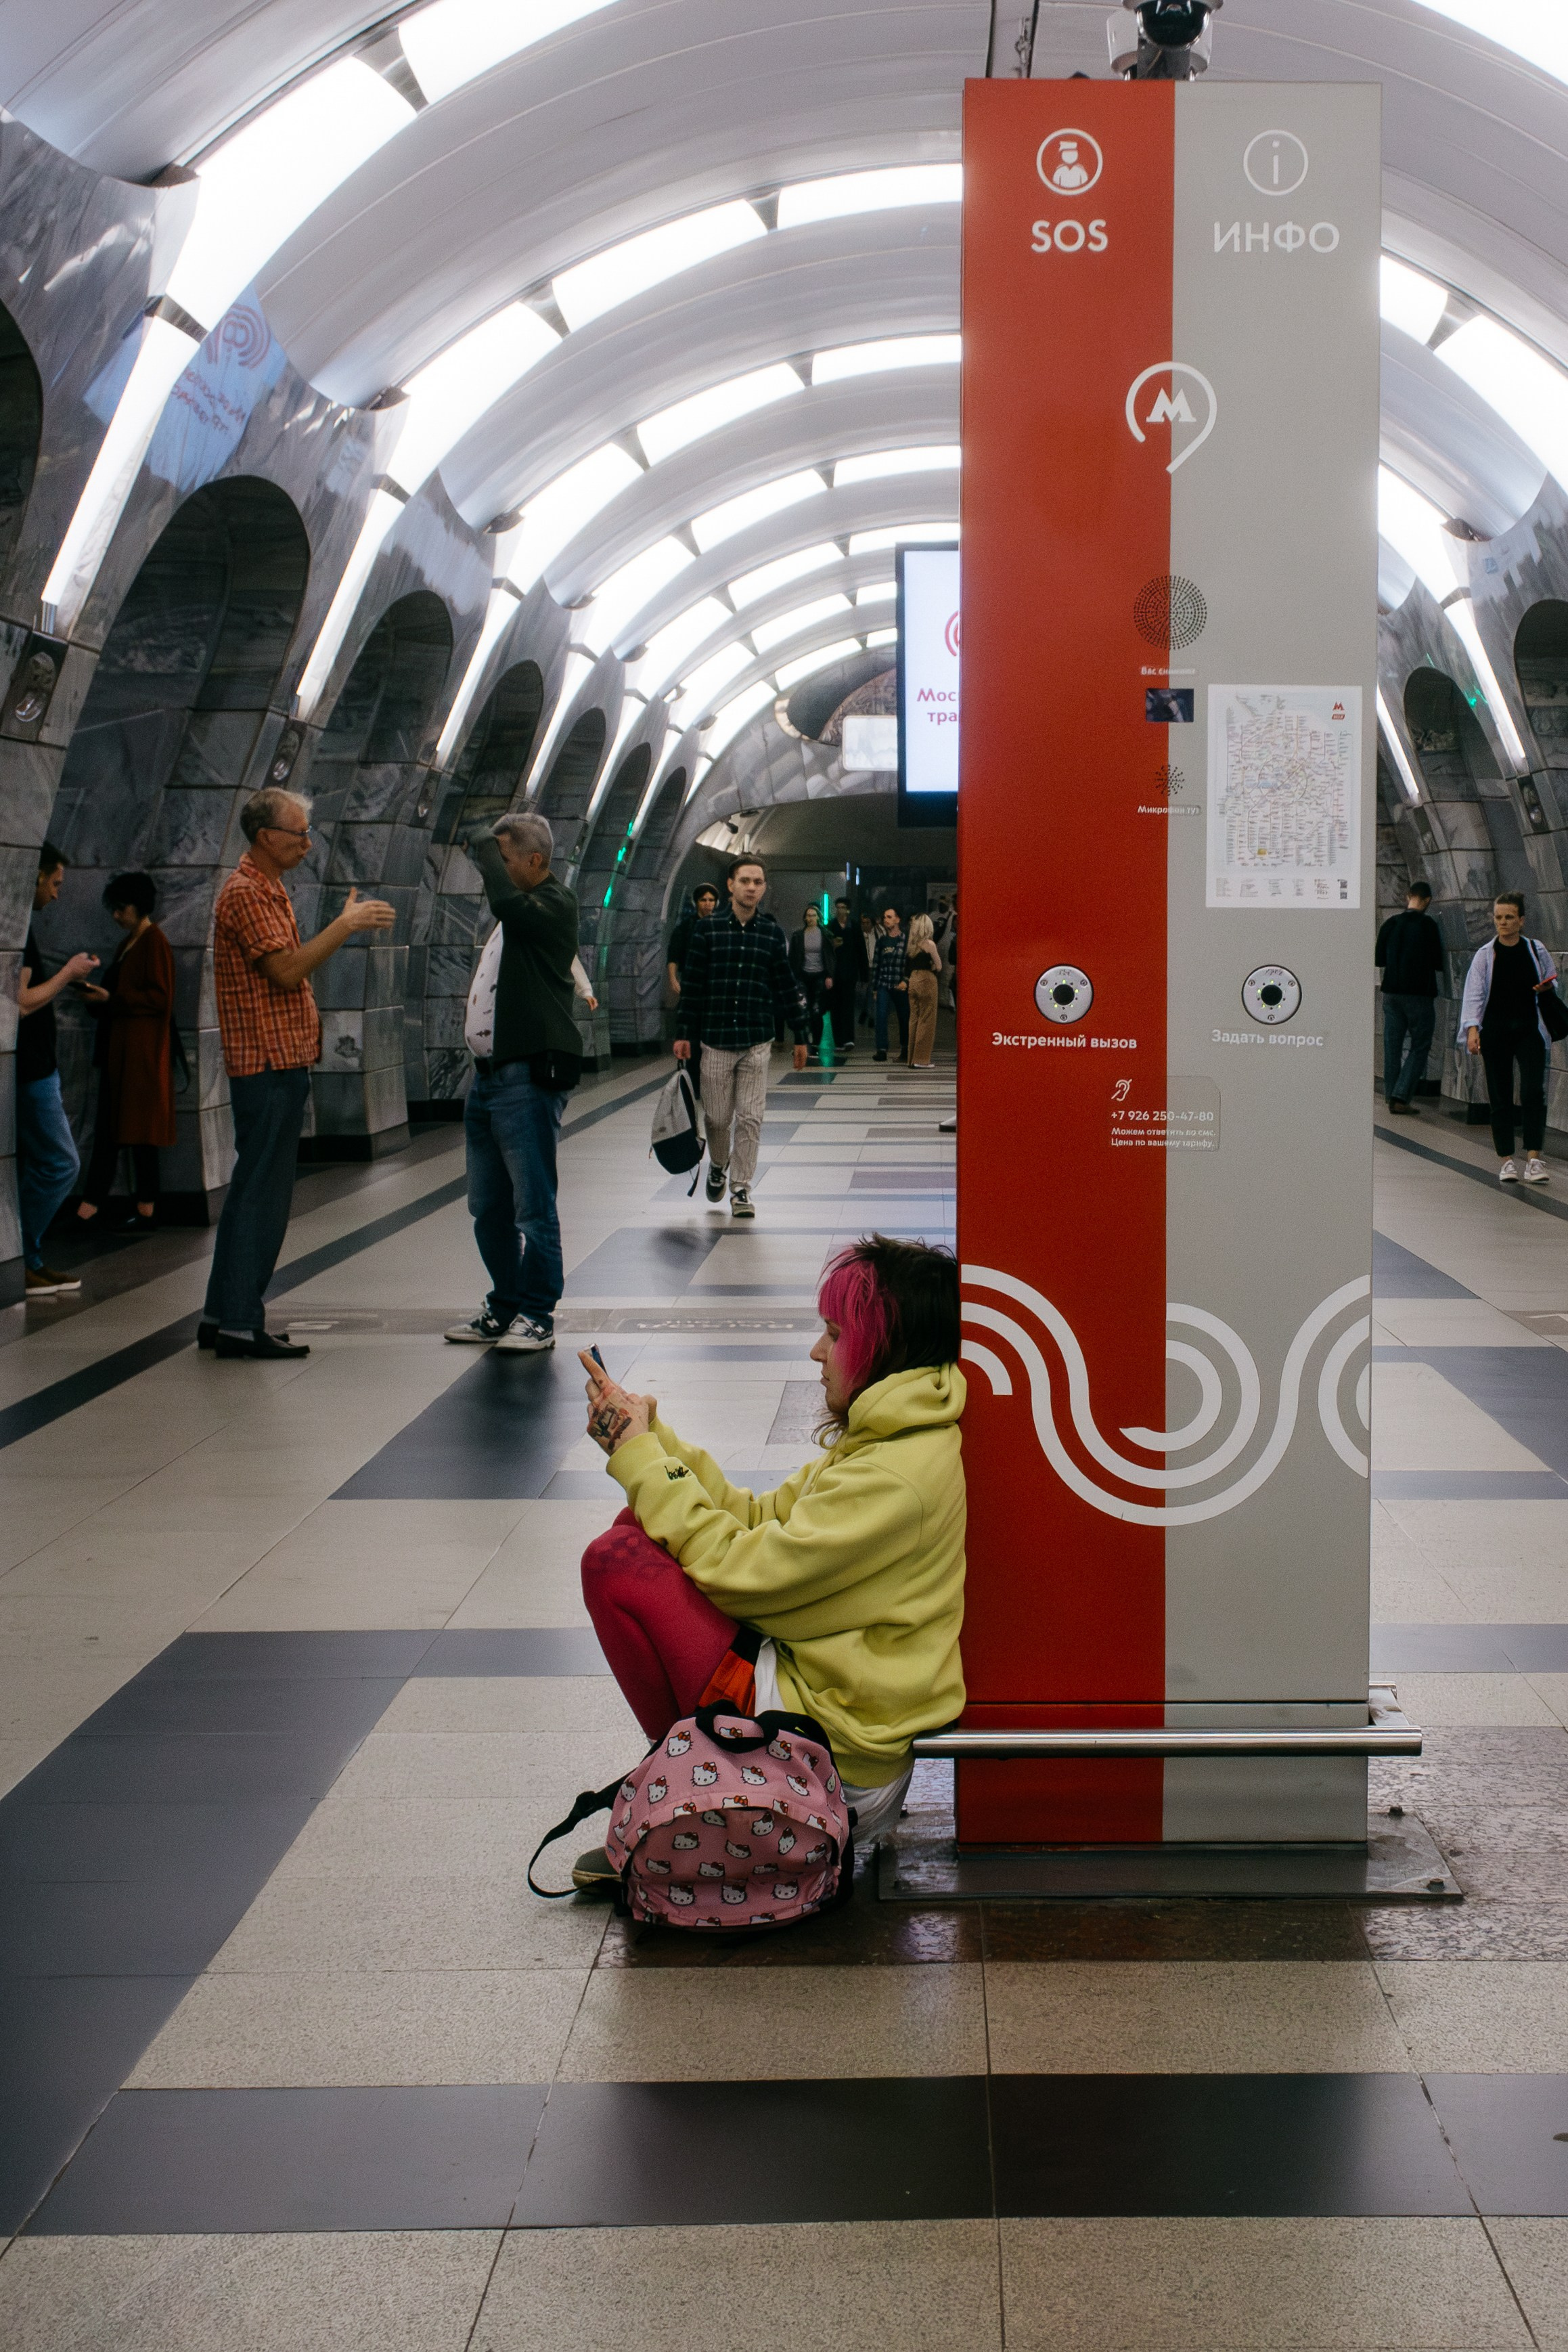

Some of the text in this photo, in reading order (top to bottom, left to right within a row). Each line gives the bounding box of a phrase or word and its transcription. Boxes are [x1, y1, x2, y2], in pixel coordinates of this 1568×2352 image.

[1031, 219, 1108, 252] SOS
[1214, 221, 1340, 253] ИНФО
[991, 1031, 1137, 1048] Экстренный вызов
[1211, 1029, 1324, 1048] Задать вопрос
[1111, 1110, 1214, 1122] +7 926 250-47-80
[1111, 1127, 1144, 1136] Можем
[1111, 1138, 1134, 1147] Цена
